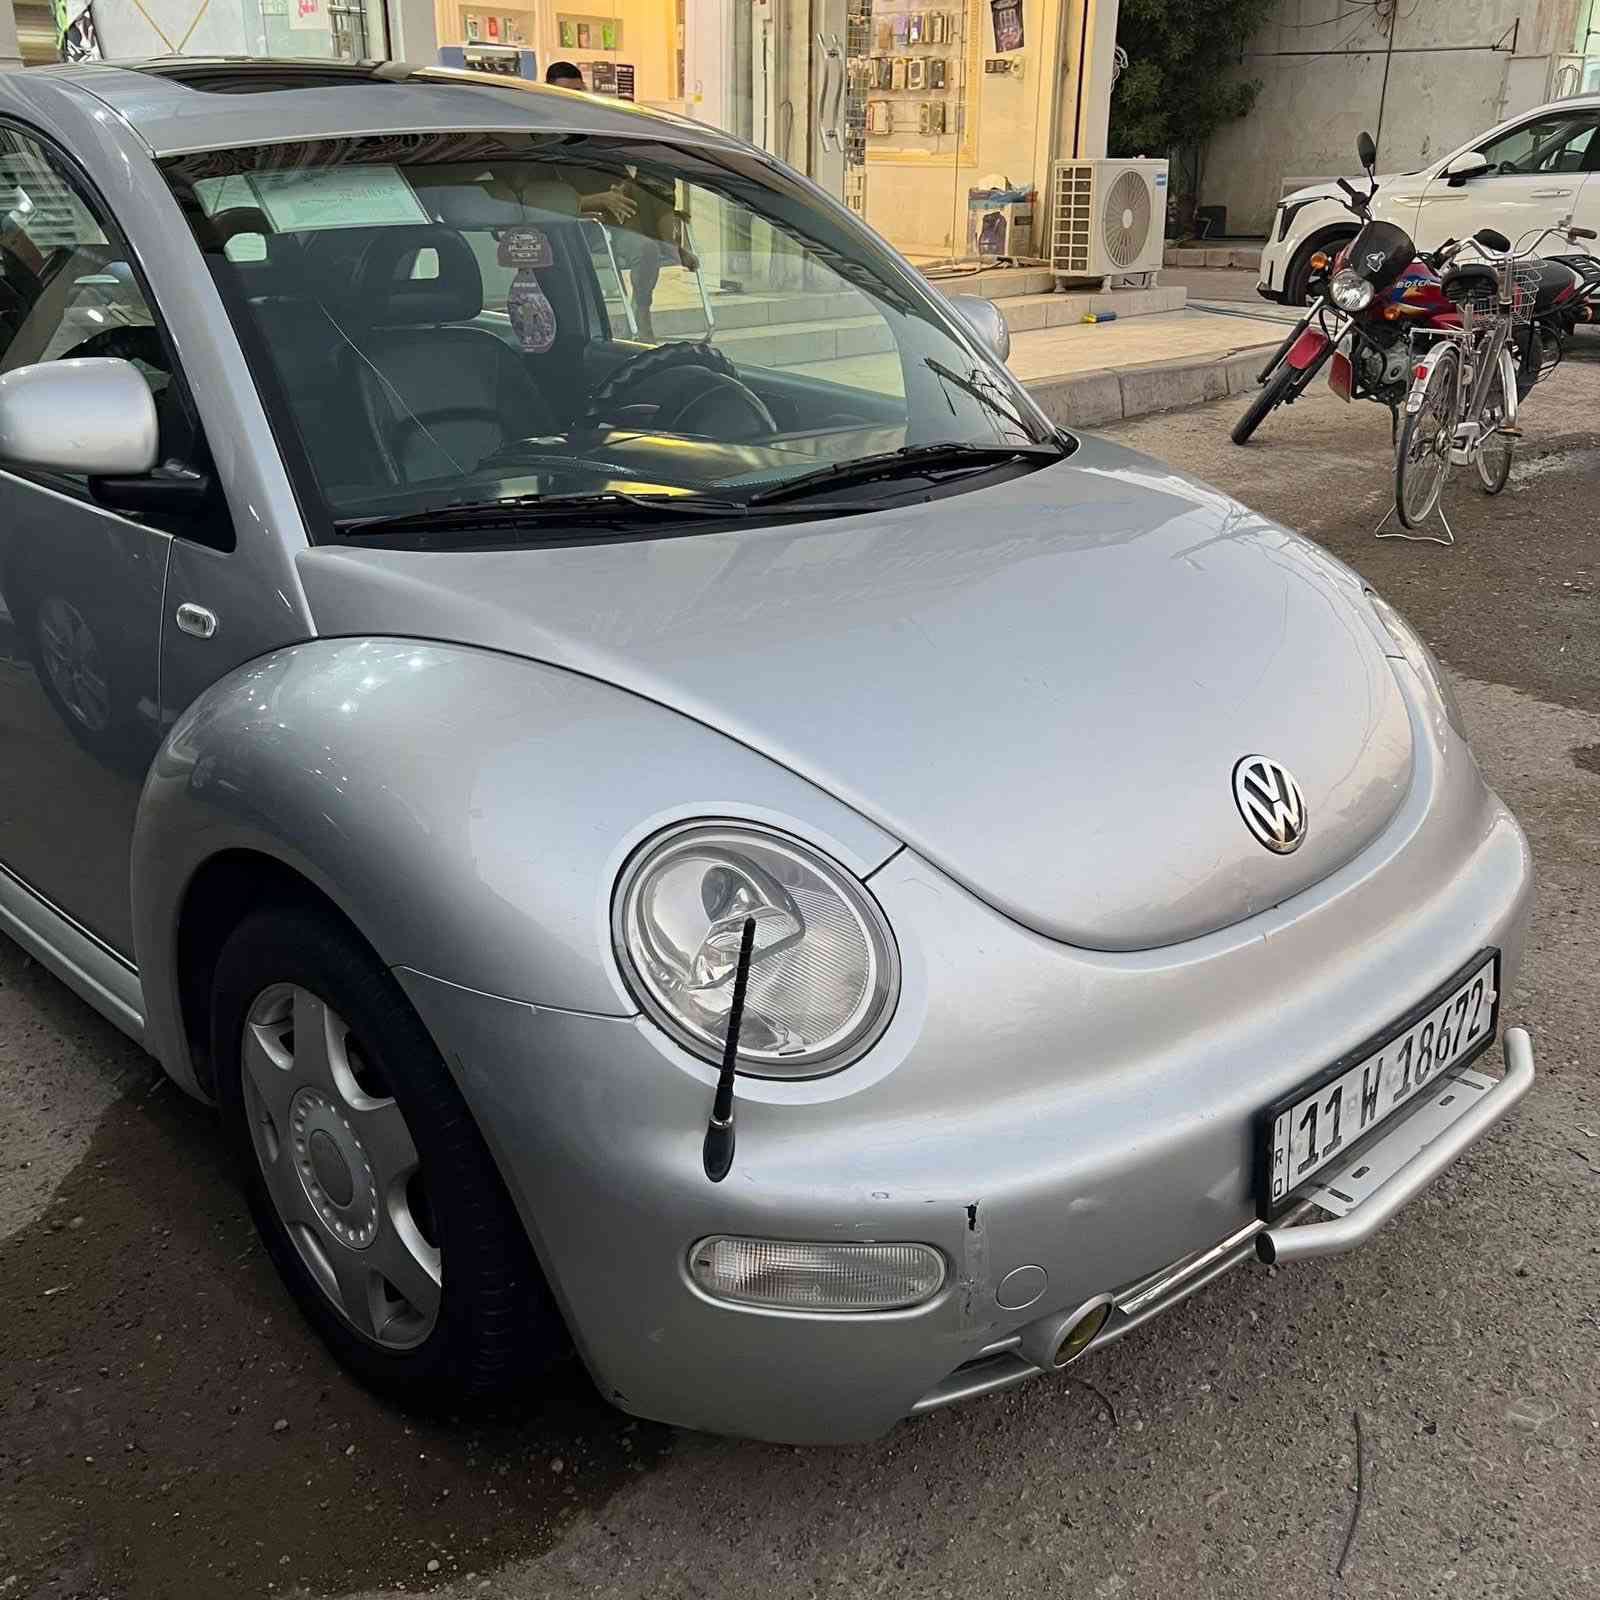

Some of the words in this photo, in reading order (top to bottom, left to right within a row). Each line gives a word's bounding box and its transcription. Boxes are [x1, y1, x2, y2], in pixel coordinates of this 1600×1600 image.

[1238, 758, 1304, 846] VW
[1298, 1085, 1343, 1175] 11
[1360, 1056, 1384, 1130] W
[1393, 977, 1484, 1103] 18672
